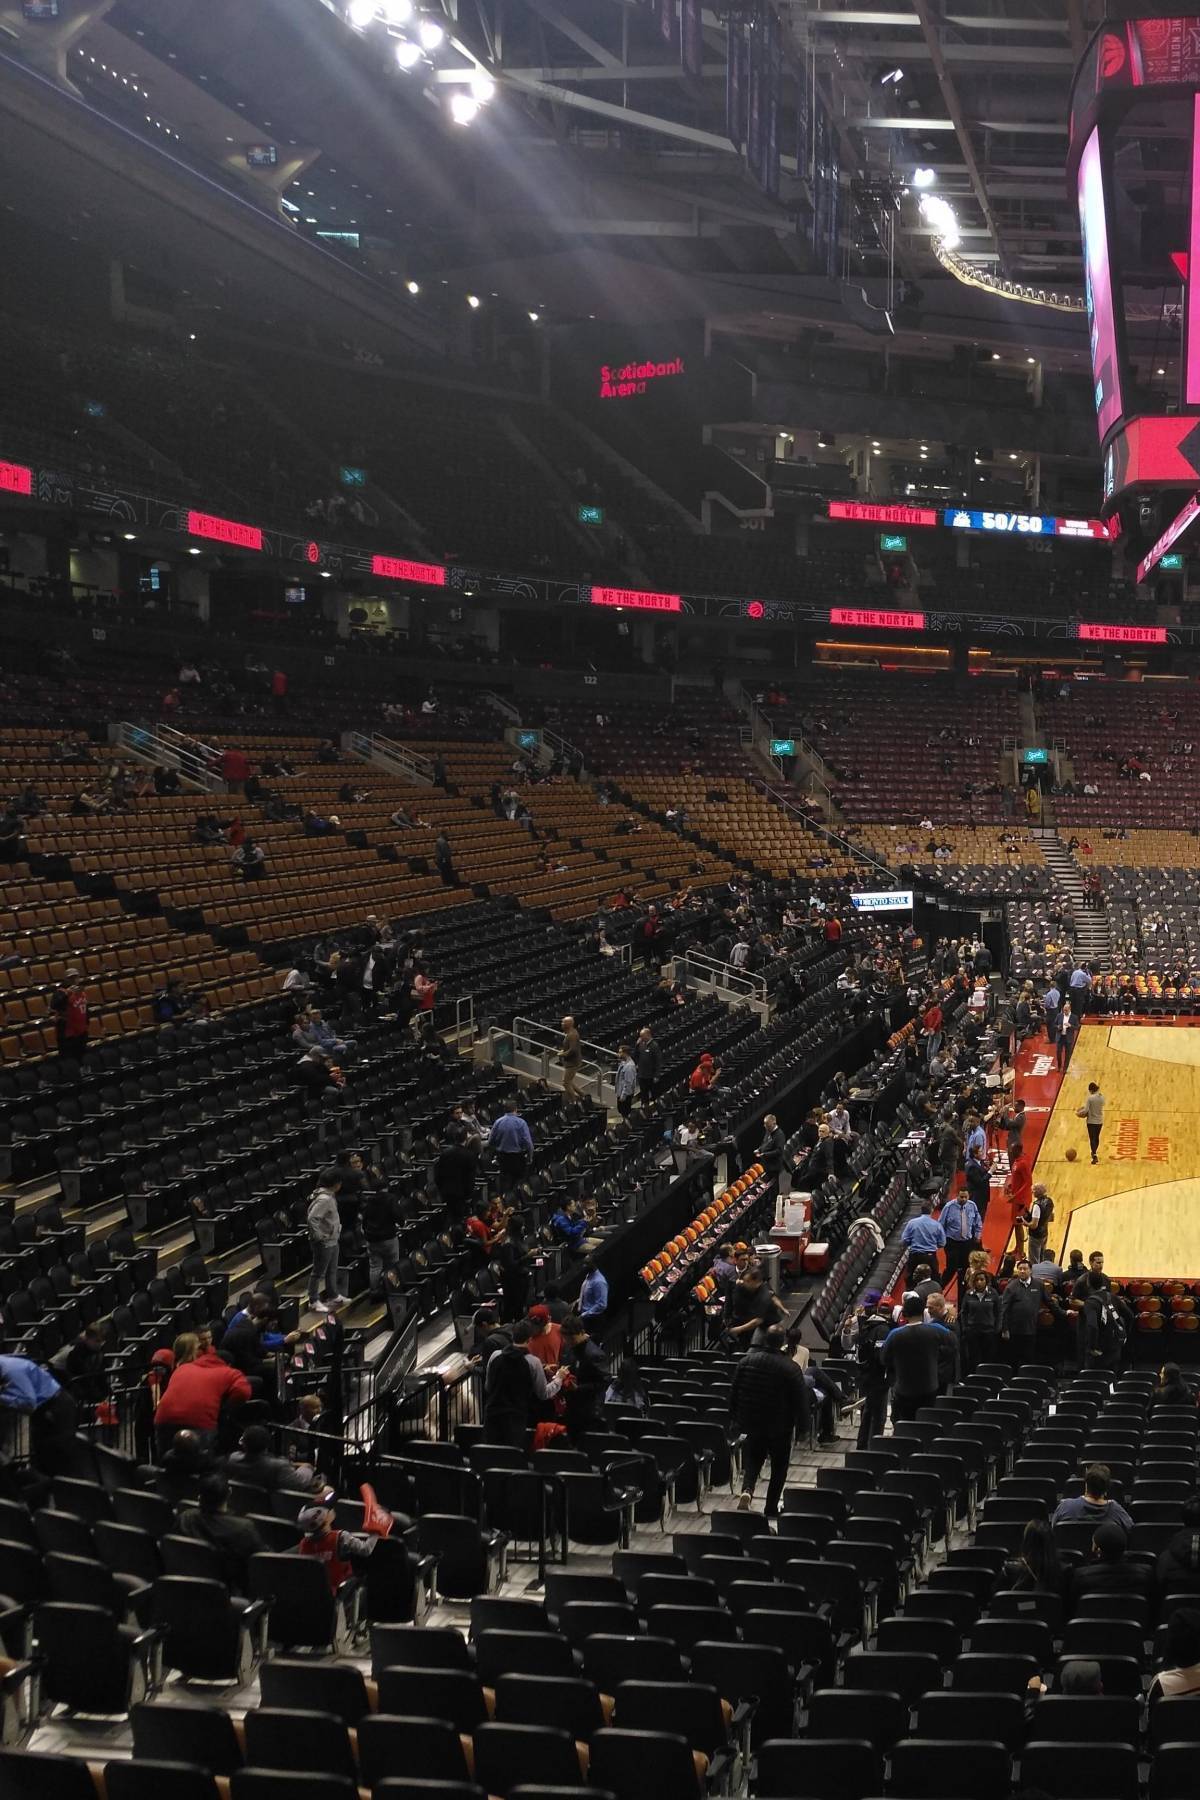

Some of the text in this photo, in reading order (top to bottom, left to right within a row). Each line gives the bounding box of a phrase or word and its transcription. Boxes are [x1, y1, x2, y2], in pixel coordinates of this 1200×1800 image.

[600, 359, 685, 382] Scotiabank
[600, 381, 647, 399] Arena
[845, 505, 921, 524] WE THE NORTH
[982, 512, 1043, 532] 50/50
[393, 561, 408, 577] THE
[409, 565, 436, 582] NORTH
[602, 590, 671, 608] WE THE NORTH
[841, 611, 914, 626] WE THE NORTH
[1088, 627, 1157, 640] WE THE NORTH
[1108, 1118, 1140, 1161] Scotiabank
[1141, 1136, 1169, 1162] Arena
